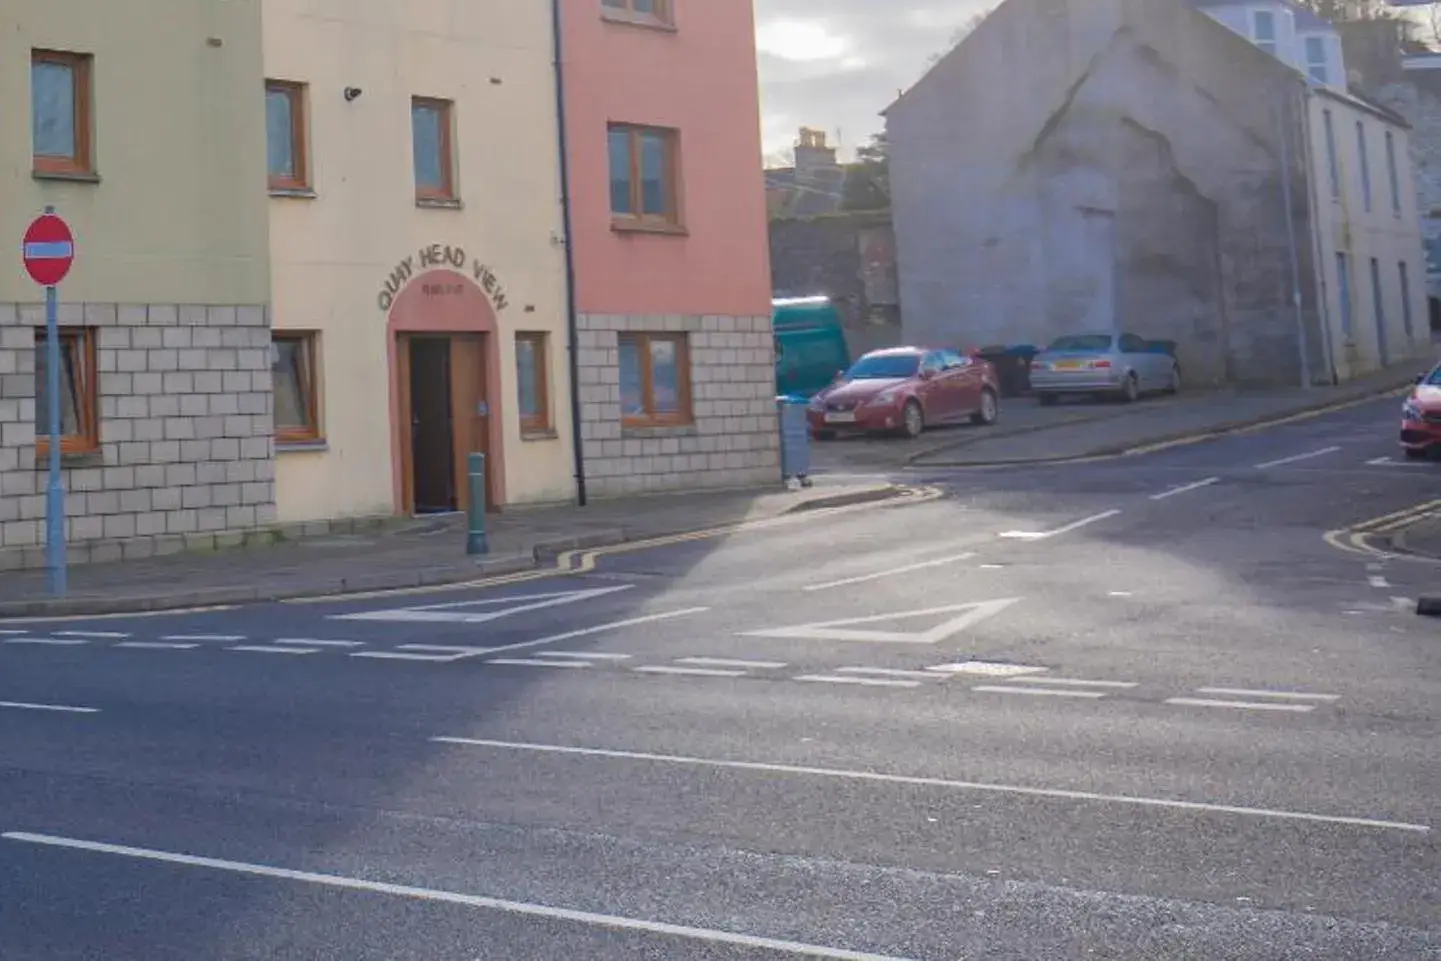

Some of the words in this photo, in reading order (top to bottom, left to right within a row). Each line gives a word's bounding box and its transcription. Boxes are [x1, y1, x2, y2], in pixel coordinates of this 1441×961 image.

[378, 255, 413, 311] QUAY
[419, 243, 466, 268] HEAD
[473, 258, 509, 311] VIEW
